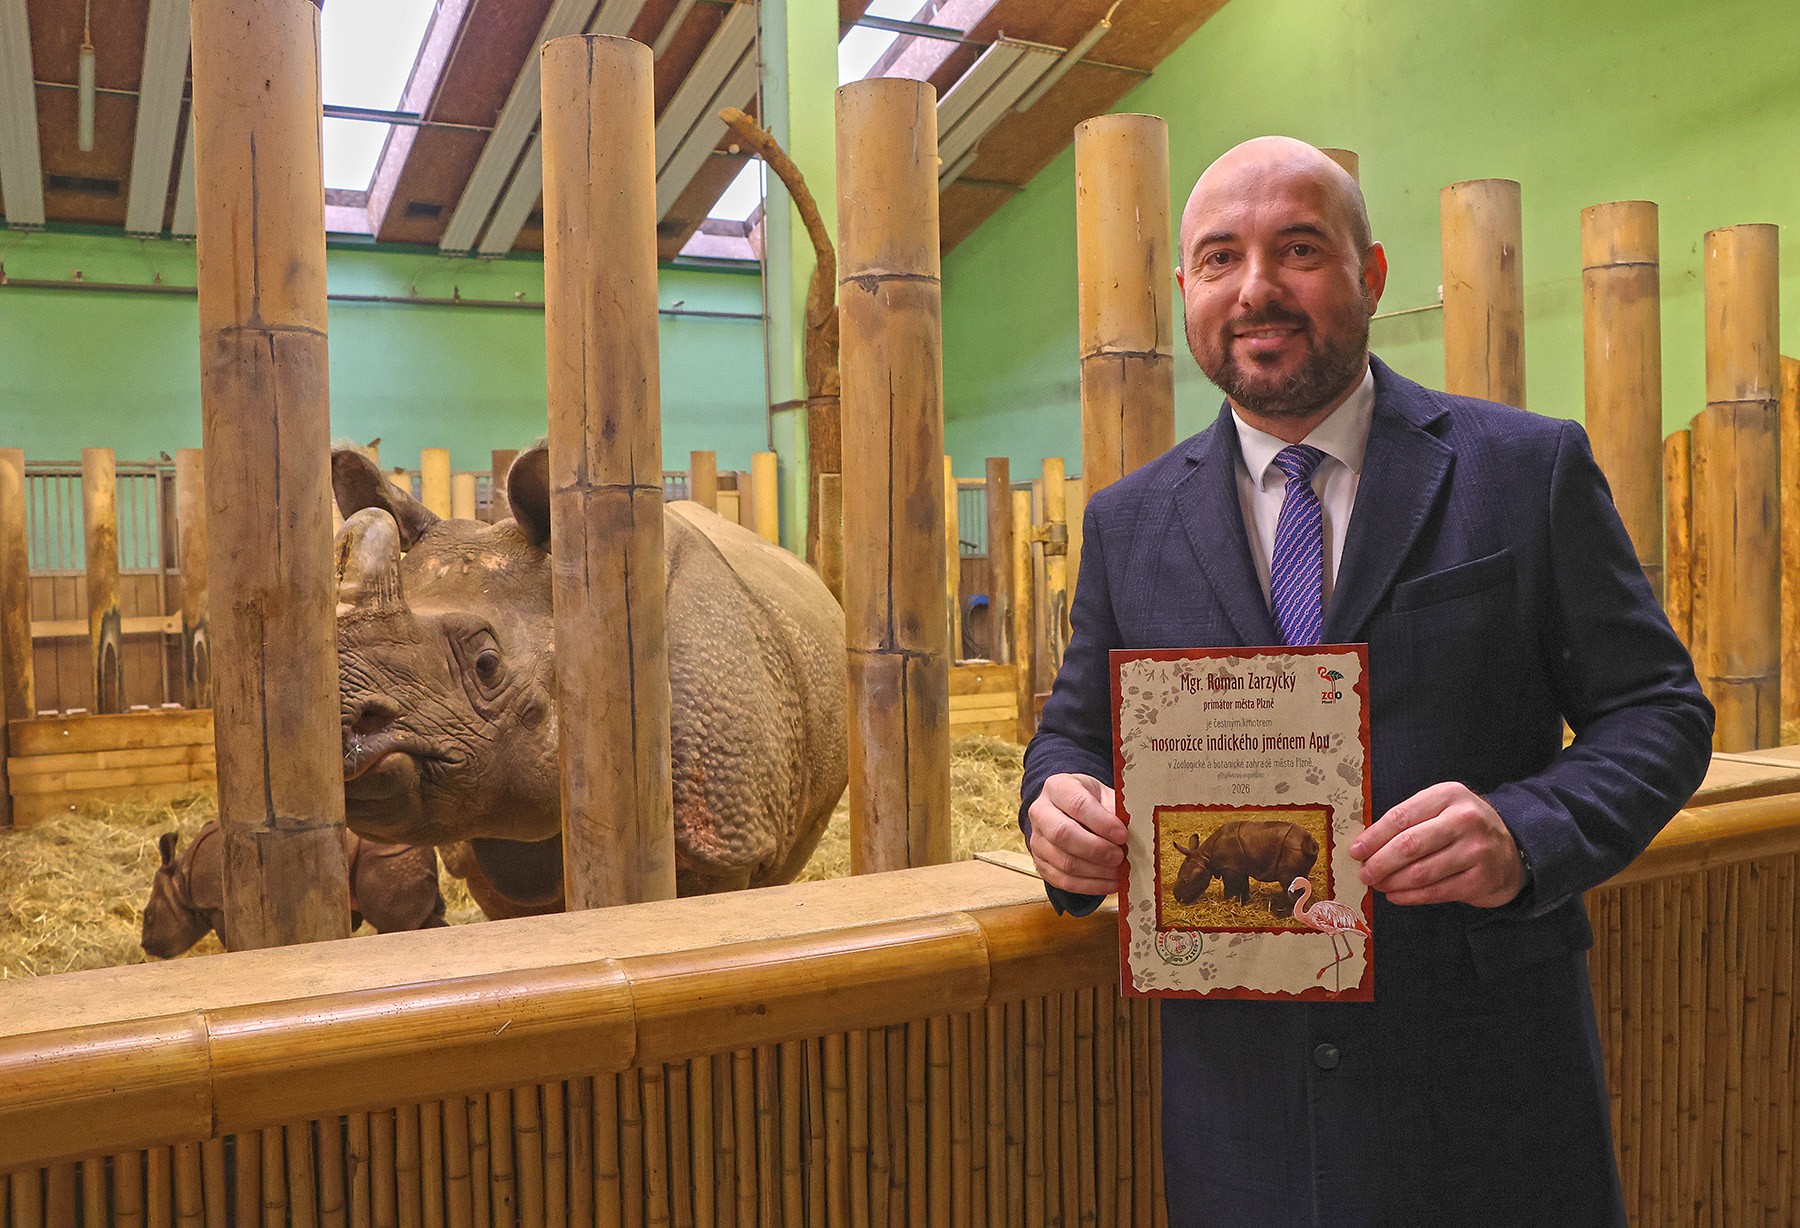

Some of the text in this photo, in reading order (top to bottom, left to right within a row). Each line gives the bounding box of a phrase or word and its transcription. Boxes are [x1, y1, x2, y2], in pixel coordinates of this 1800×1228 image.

[1181, 671, 1296, 695] Mgr. Roman Zarzycký
[1203, 697, 1275, 712] primátor města Plzně
[1206, 718, 1273, 731] je čestným kmotrem
[1151, 731, 1330, 753] nosorožce indického jménem Apu
[1173, 759, 1206, 772] Zoologické
[1206, 761, 1212, 769] a
[1213, 759, 1244, 769] botanické
[1245, 759, 1272, 769] zahradě
[1273, 757, 1295, 768] města
[1231, 783, 1251, 795] 2026
